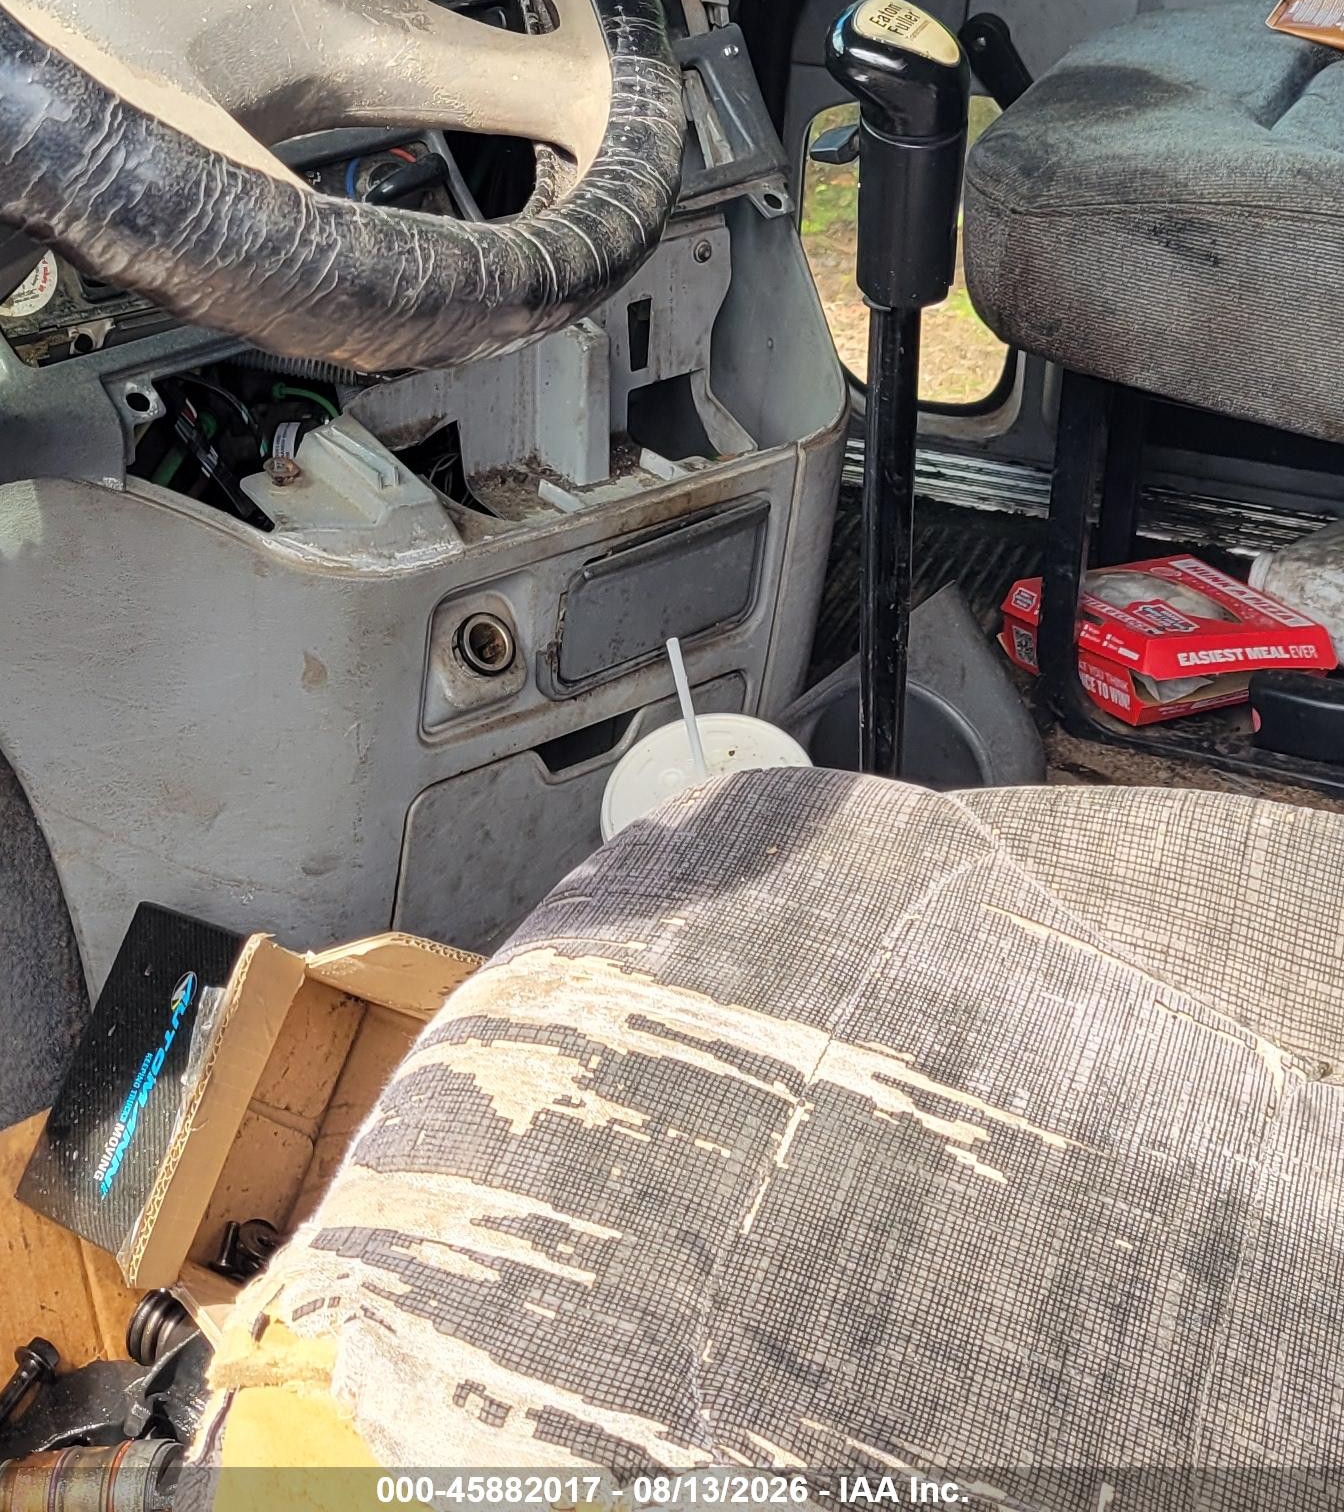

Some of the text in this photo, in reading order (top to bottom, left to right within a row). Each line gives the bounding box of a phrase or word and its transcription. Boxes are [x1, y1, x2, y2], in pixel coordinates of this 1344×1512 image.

[869, 2, 903, 28] Eaton
[887, 10, 921, 36] Fuller
[1176, 645, 1318, 667] EASIEST MEAL EVER
[1097, 680, 1110, 700] TO
[1109, 687, 1131, 711] WIN!
[132, 1052, 153, 1089] KEEPING
[93, 1122, 126, 1182] MOVING
